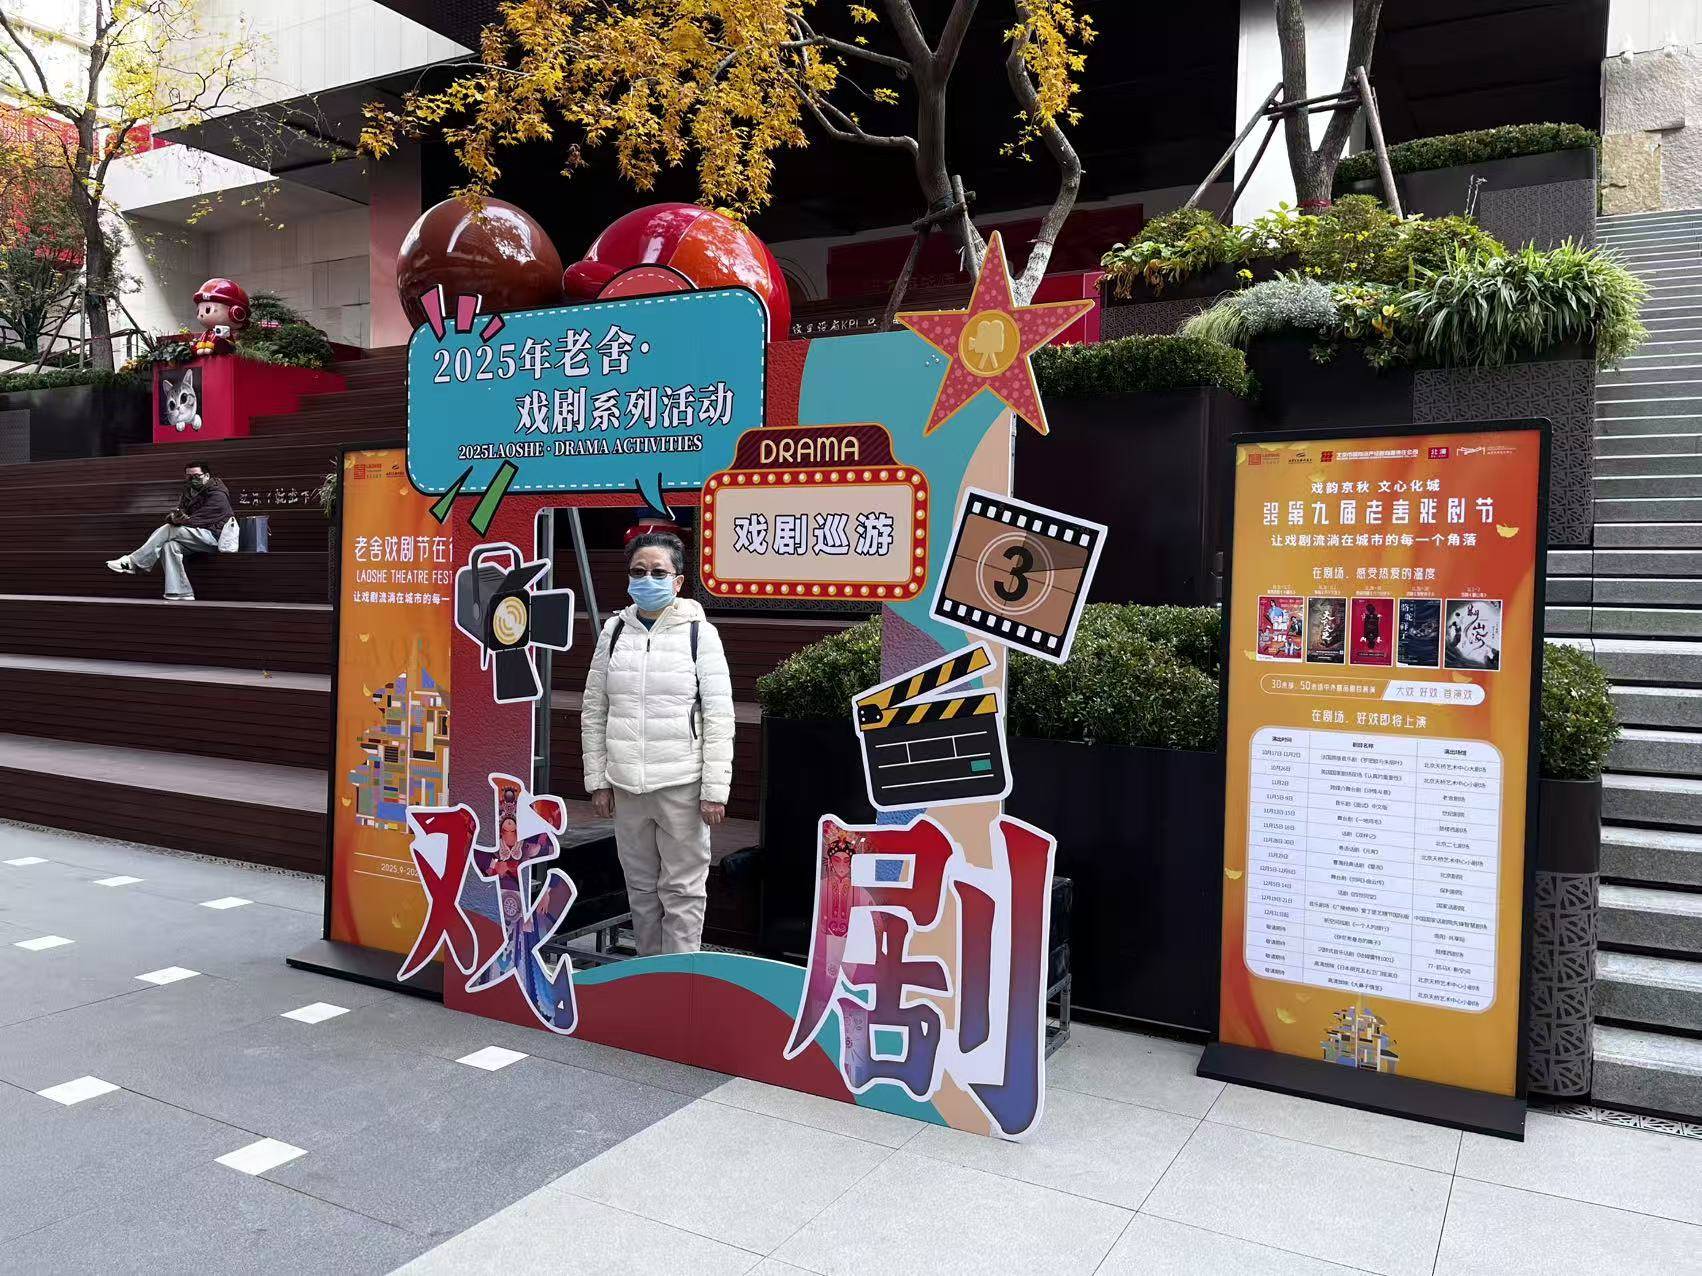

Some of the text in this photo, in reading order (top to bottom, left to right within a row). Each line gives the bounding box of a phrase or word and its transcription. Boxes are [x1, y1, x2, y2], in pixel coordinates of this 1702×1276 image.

[514, 382, 735, 435] 戏剧系列活动
[612, 434, 703, 454] ACTIVITIES
[760, 436, 859, 464] DRAMA
[1311, 479, 1441, 494] 戏韵京秋 文心化城
[733, 512, 894, 556] 戏剧巡游
[1271, 533, 1478, 547] 让戏剧流淌在城市的每一个角落
[356, 569, 387, 583] LAOSHE
[390, 570, 429, 584] THEATRE
[993, 545, 1034, 602] 3
[396, 772, 1058, 1142] 戏 剧
